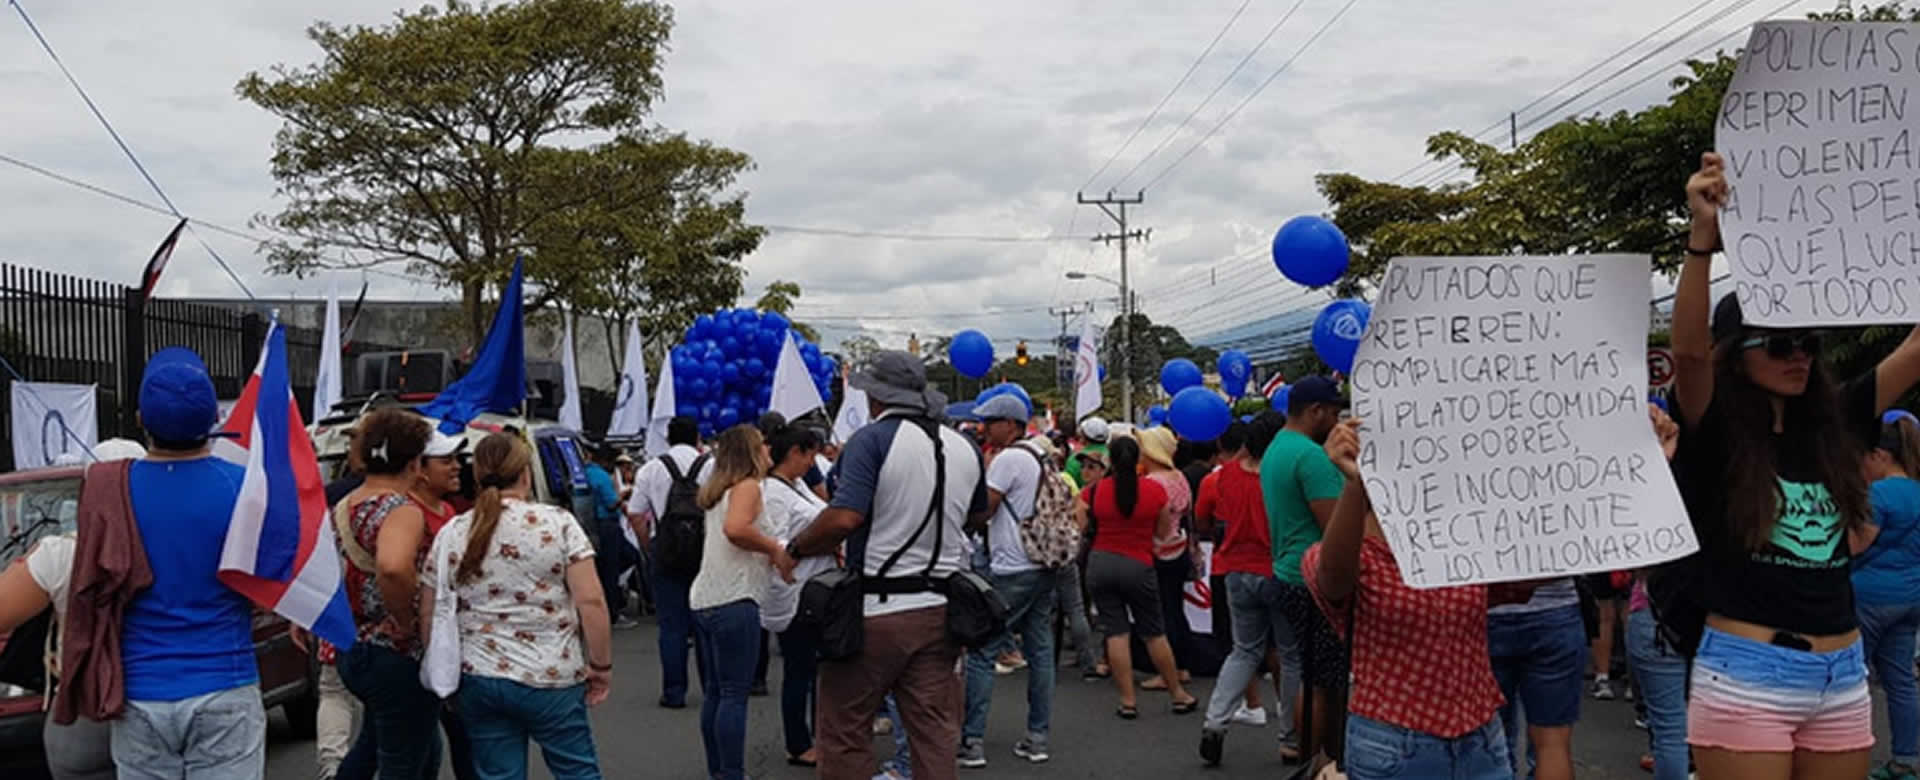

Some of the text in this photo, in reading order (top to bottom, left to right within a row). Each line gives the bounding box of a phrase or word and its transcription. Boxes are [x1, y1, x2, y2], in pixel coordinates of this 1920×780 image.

[1746, 26, 1909, 73] POLICIAS
[1721, 83, 1908, 133] REPRIMEN
[1730, 129, 1920, 179] VIOLENTA
[1757, 184, 1835, 224] LAS
[1534, 264, 1599, 301] QUE
[1735, 276, 1908, 317] POR TODOS
[1353, 341, 1621, 393] COMPLICARLE MÁS
[1394, 396, 1482, 430] PLATO
[1487, 388, 1525, 421] DE
[1528, 385, 1638, 420] COMIDA
[1360, 419, 1582, 473] A LOS POBRES,
[1366, 452, 1649, 518] QUE INCOMODAR
[1410, 522, 1690, 584] A LOS MILLONARIOS
